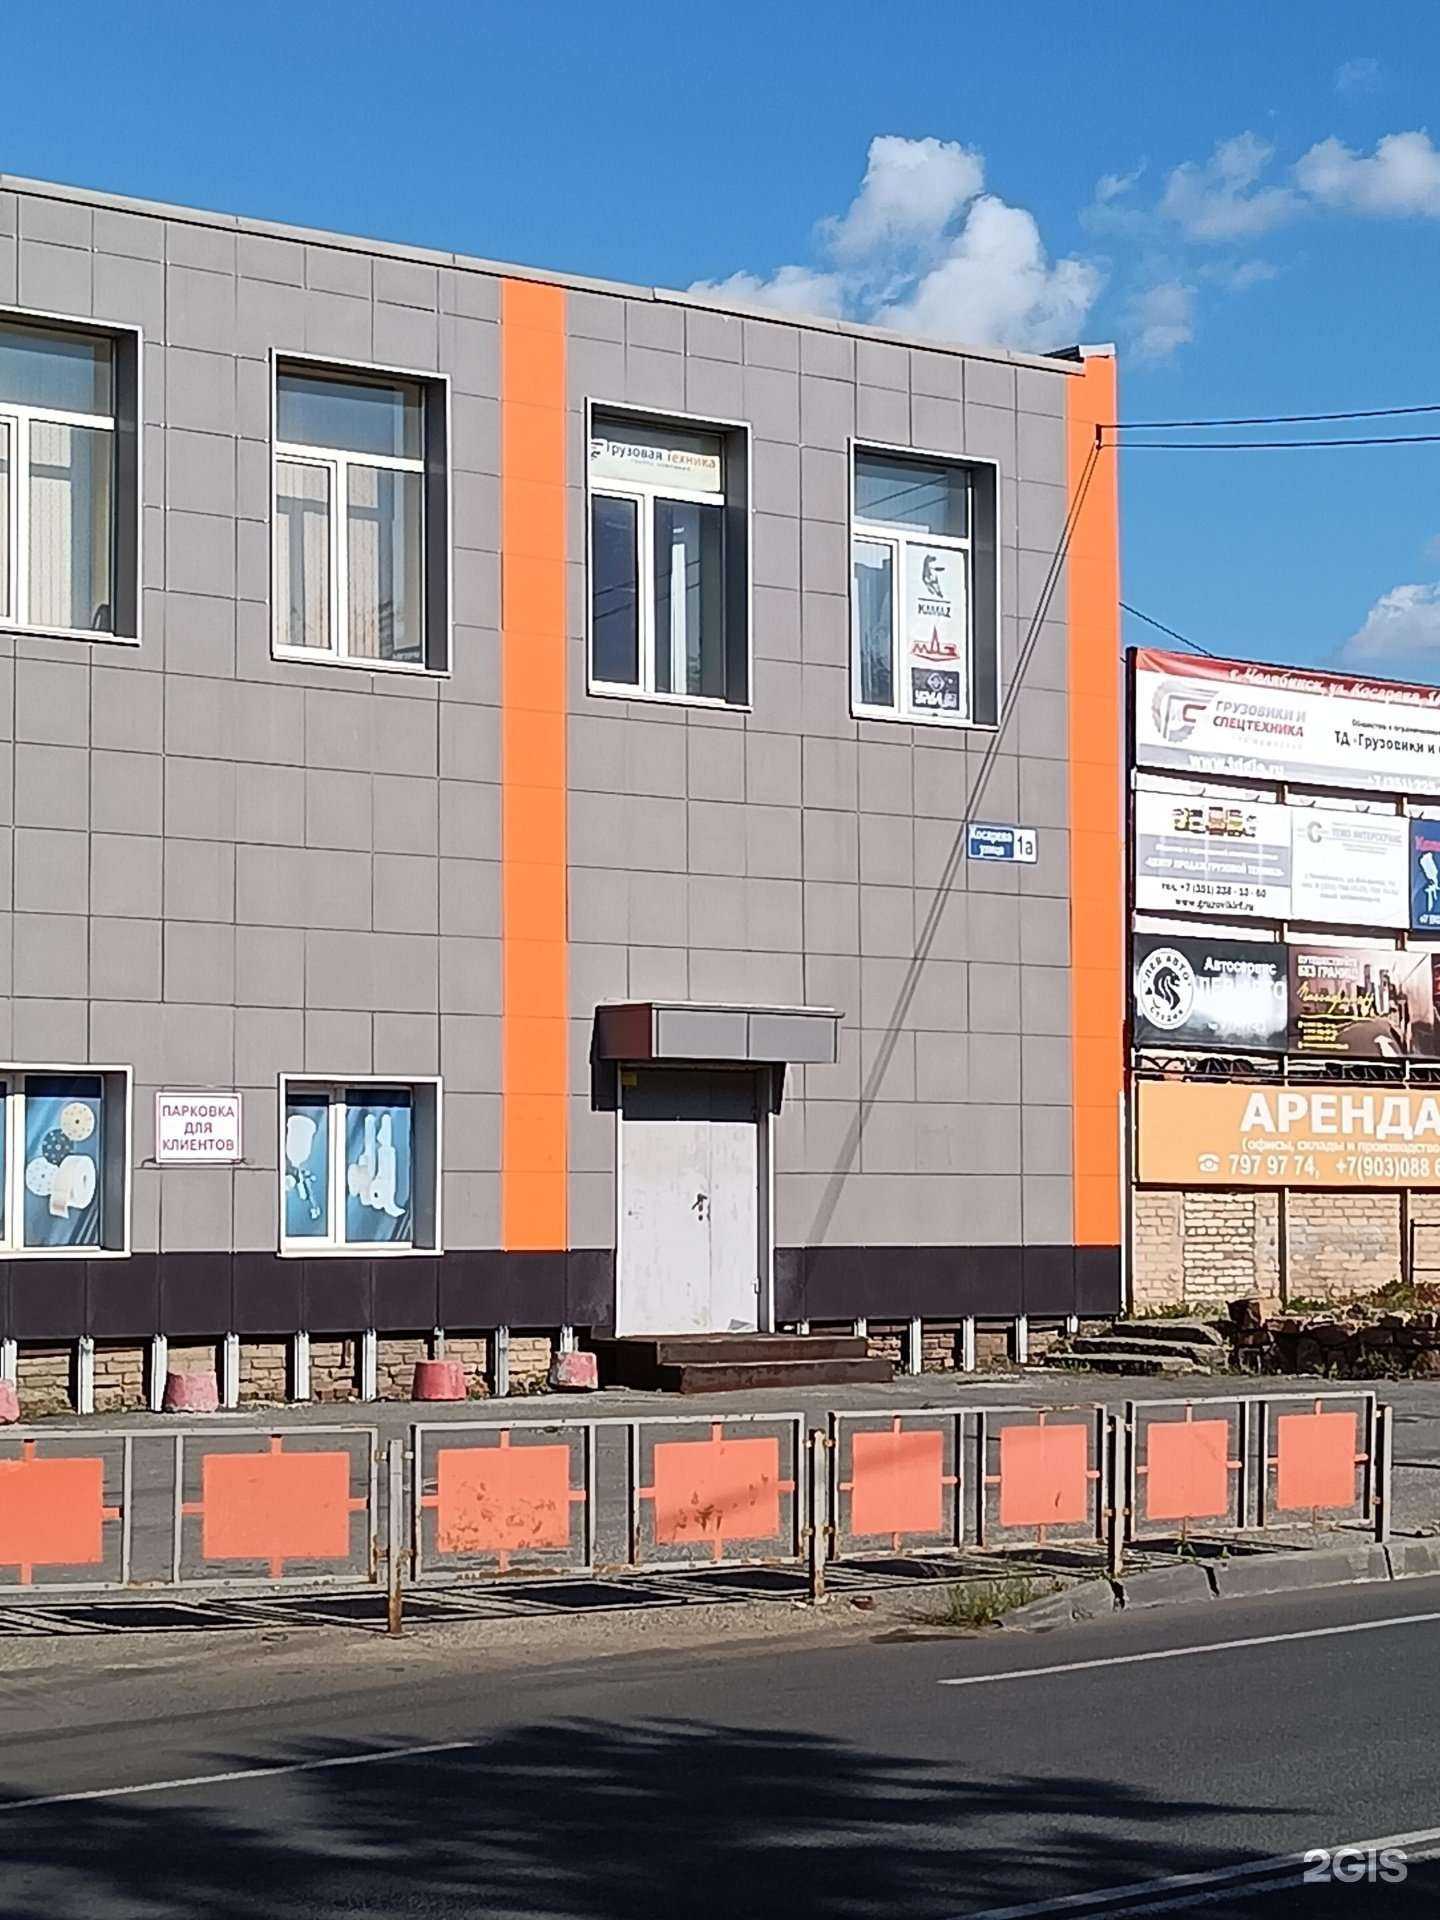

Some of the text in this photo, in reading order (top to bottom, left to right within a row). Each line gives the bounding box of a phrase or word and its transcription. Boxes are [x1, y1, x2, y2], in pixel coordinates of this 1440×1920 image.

[1216, 700, 1293, 721] ГРУЗОВИКИ
[1212, 715, 1304, 737] СПЕЦТЕХНИКА
[1016, 836, 1034, 857] 1а
[162, 1105, 235, 1117] ПАРКОВКА
[1240, 1092, 1440, 1140] АРЕНДА
[184, 1121, 213, 1135] ДЛЯ
[162, 1138, 235, 1151] КЛИЕНТОВ
[1229, 1154, 1261, 1176] 797
[1267, 1155, 1288, 1176] 97
[1294, 1155, 1320, 1180] 74,
[1336, 1155, 1430, 1182] +7(903)088
